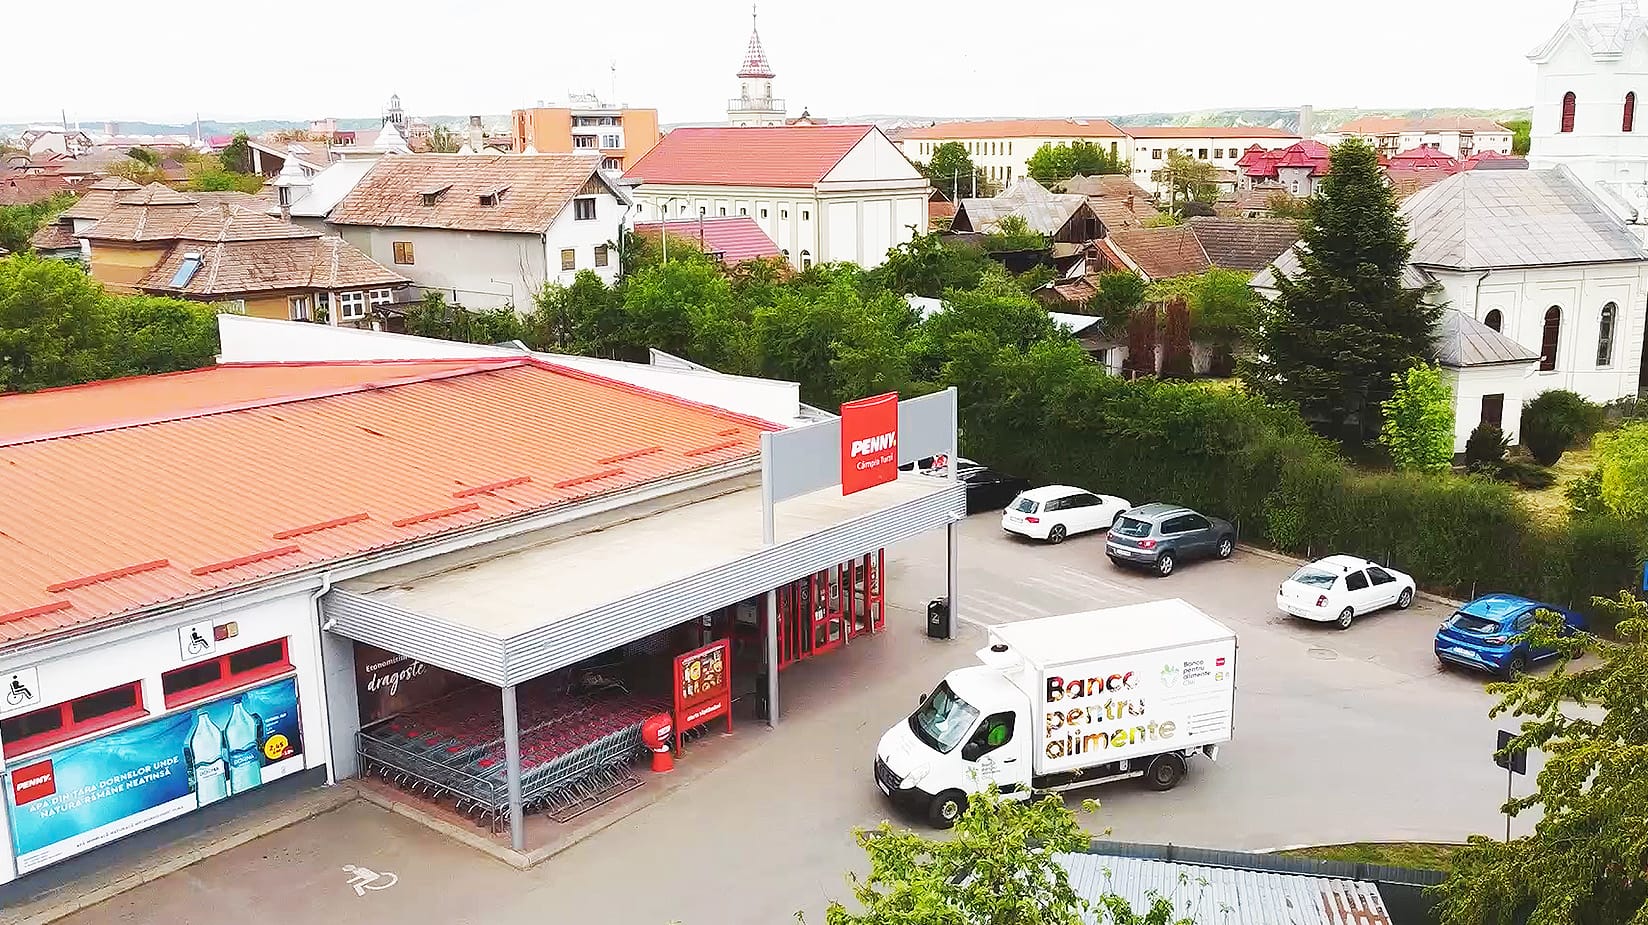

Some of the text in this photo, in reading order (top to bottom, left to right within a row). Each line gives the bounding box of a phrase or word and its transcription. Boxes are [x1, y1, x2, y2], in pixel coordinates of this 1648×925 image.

[368, 660, 424, 696] dragoste
[1046, 699, 1144, 738] pentru
[1046, 720, 1176, 759] alimente
[29, 801, 49, 813] APA
[52, 793, 70, 804] DIN
[100, 766, 152, 789] DORNELOR
[153, 756, 179, 770] UNDE
[40, 800, 83, 818] NATURA
[126, 767, 171, 789] NEATINSĂ
